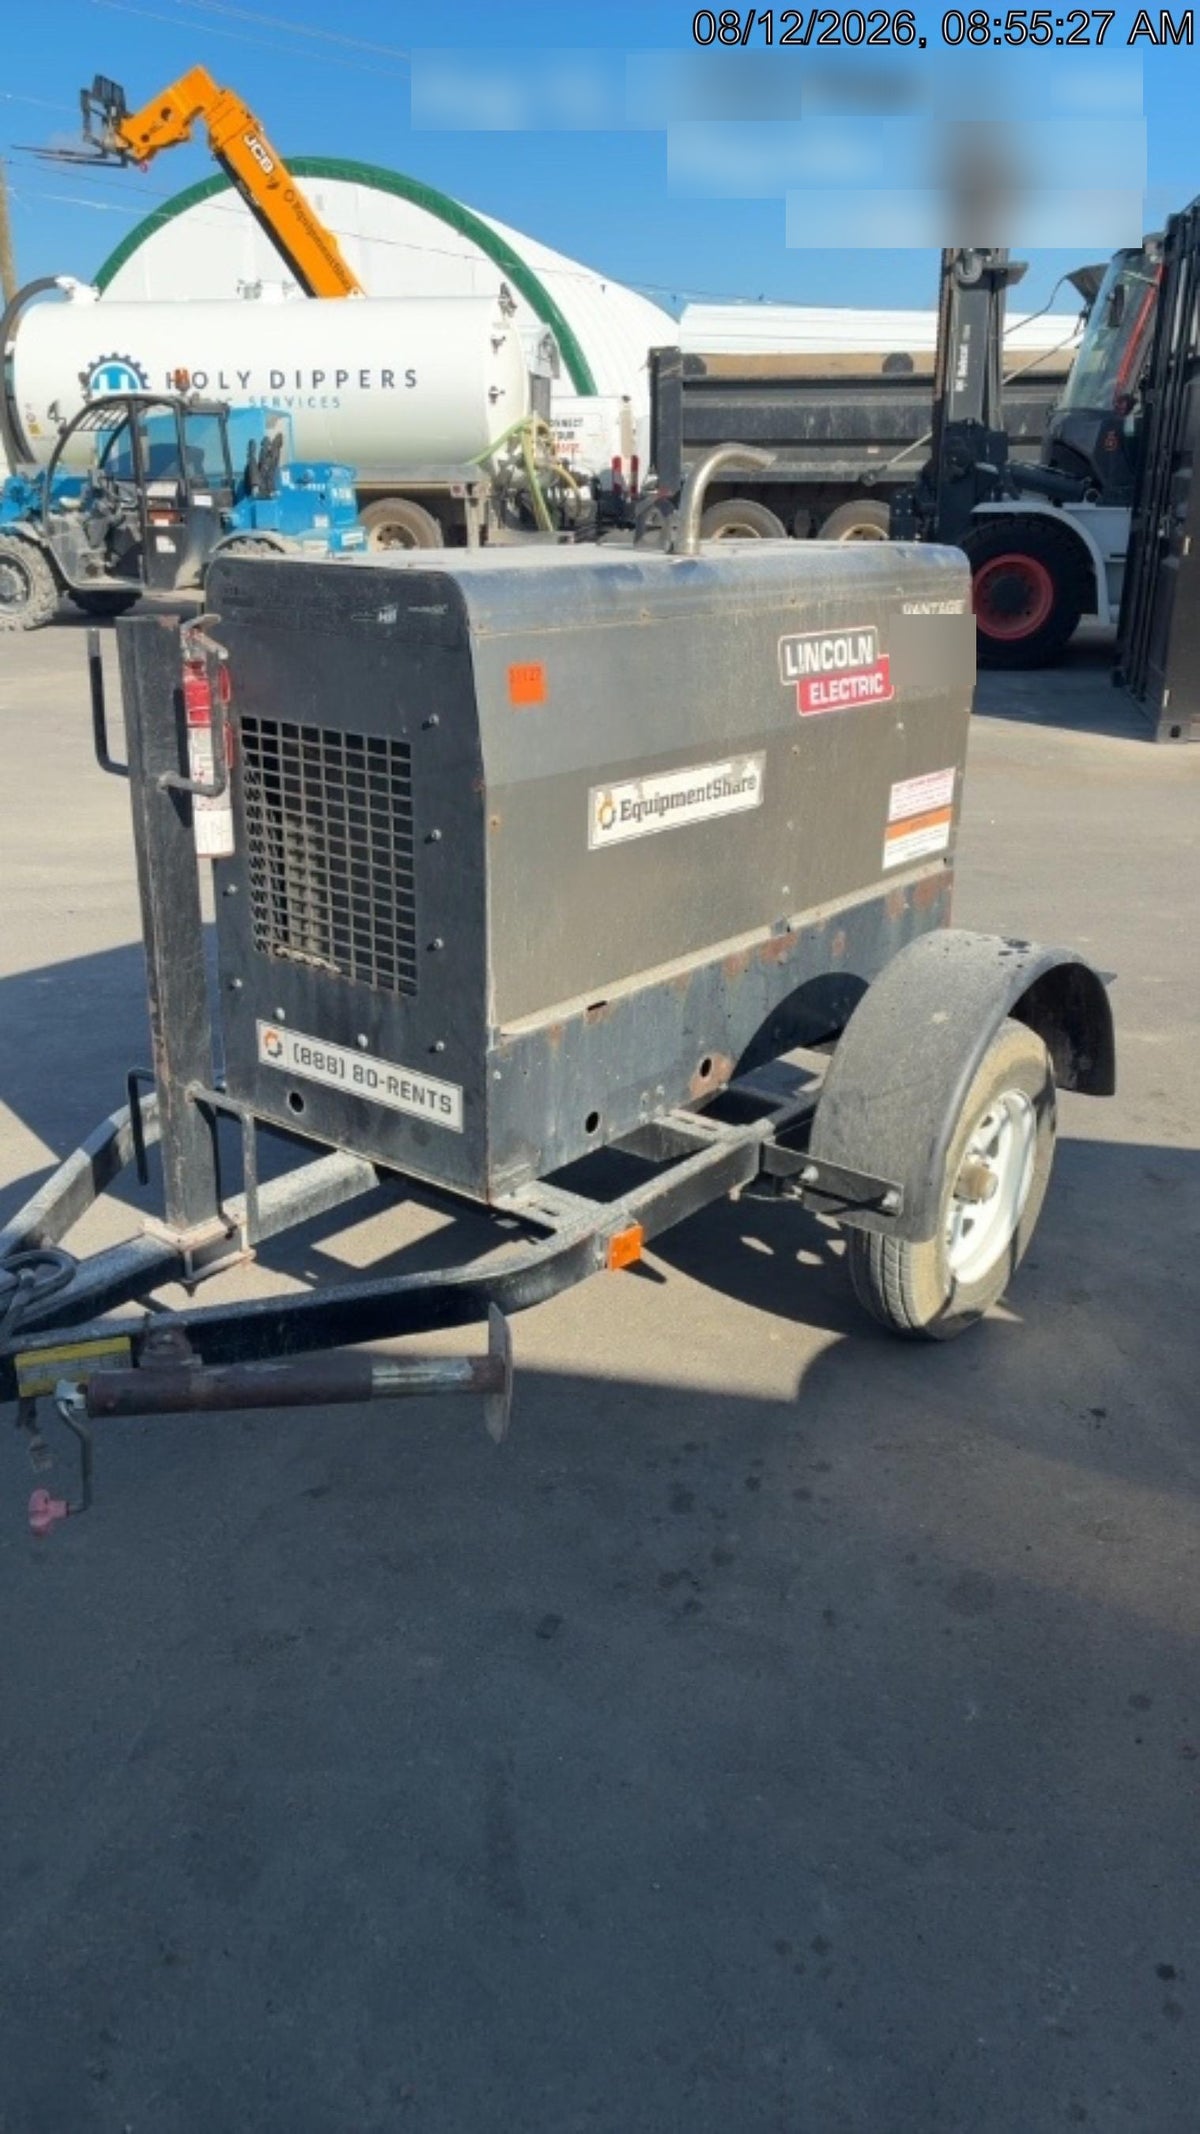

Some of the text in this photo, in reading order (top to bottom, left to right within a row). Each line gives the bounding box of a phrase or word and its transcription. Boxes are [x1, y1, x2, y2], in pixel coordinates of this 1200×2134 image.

[243, 134, 274, 174] JCB
[269, 369, 417, 390] DIPPERS
[248, 396, 341, 409] SERVICES
[785, 635, 874, 677] LINCOLN
[809, 673, 884, 706] ELECTRIC
[620, 774, 757, 823] EquipmentShare
[293, 1042, 452, 1115] (888) 80-RENTS
